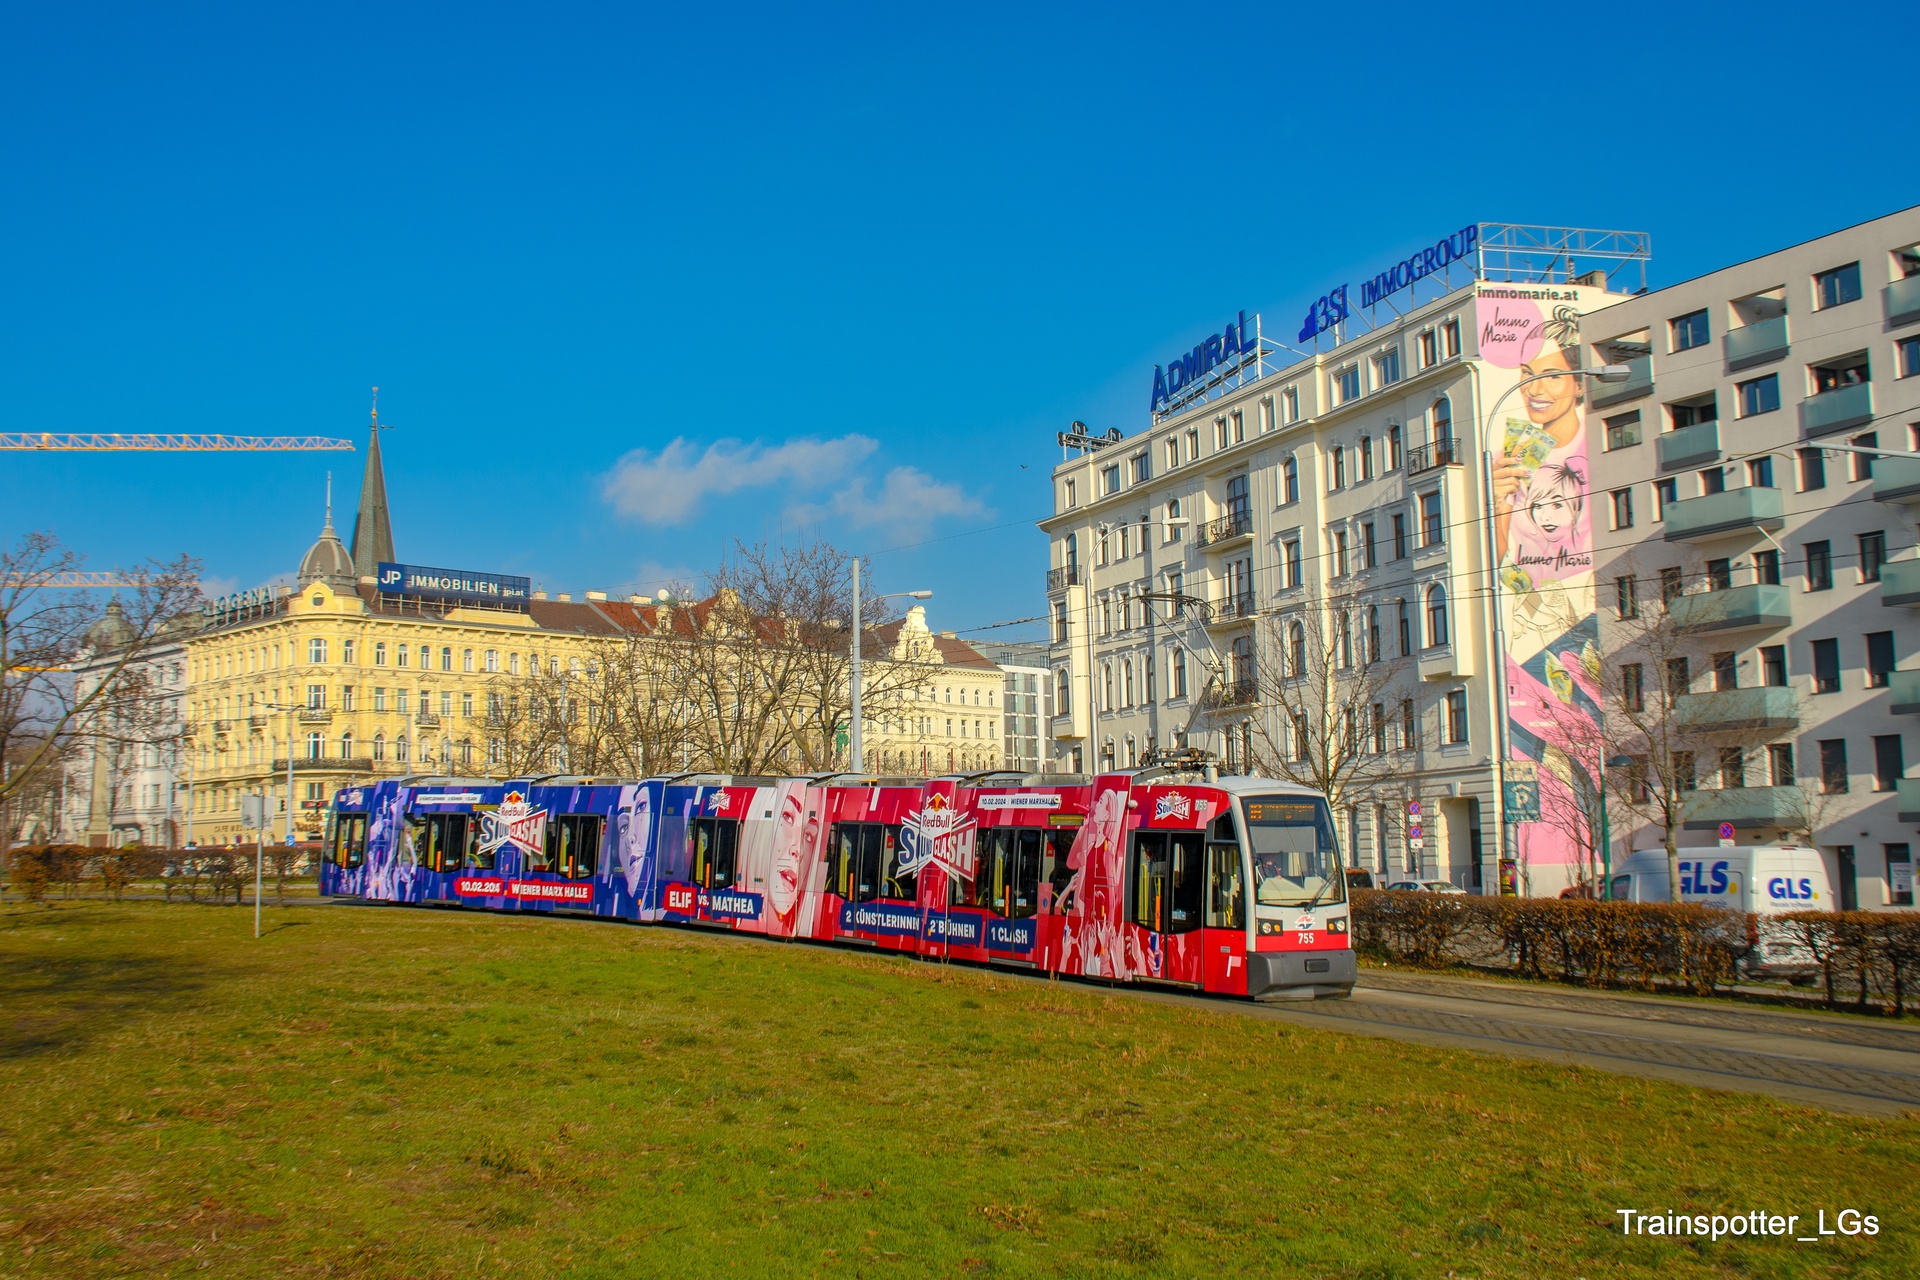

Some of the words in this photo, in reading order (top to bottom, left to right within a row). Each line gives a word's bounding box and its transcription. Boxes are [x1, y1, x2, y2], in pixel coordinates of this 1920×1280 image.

[1360, 224, 1478, 309] IMMOGROUP
[1477, 286, 1578, 301] immomarie.at
[1494, 306, 1530, 328] Immo
[1481, 321, 1517, 347] Marie
[1150, 309, 1258, 412] ADMIRAL
[1517, 544, 1554, 566] Immo
[1555, 545, 1592, 571] Marie
[381, 570, 401, 584] JP
[411, 575, 498, 594] IMMOBILIEN
[513, 806, 526, 817] Bull
[922, 814, 935, 828] Red
[936, 815, 950, 828] Bull
[933, 829, 974, 872] CLASH
[541, 885, 563, 897] MARX
[564, 887, 588, 898] HALLE
[669, 890, 692, 908] ELIF
[712, 896, 754, 914] MATHEA
[845, 910, 852, 923] 2
[930, 919, 936, 933] 2
[938, 919, 975, 938] BÜHNEN
[991, 927, 996, 940] 1
[998, 927, 1028, 944] CLASH
[1298, 932, 1315, 945] 755
